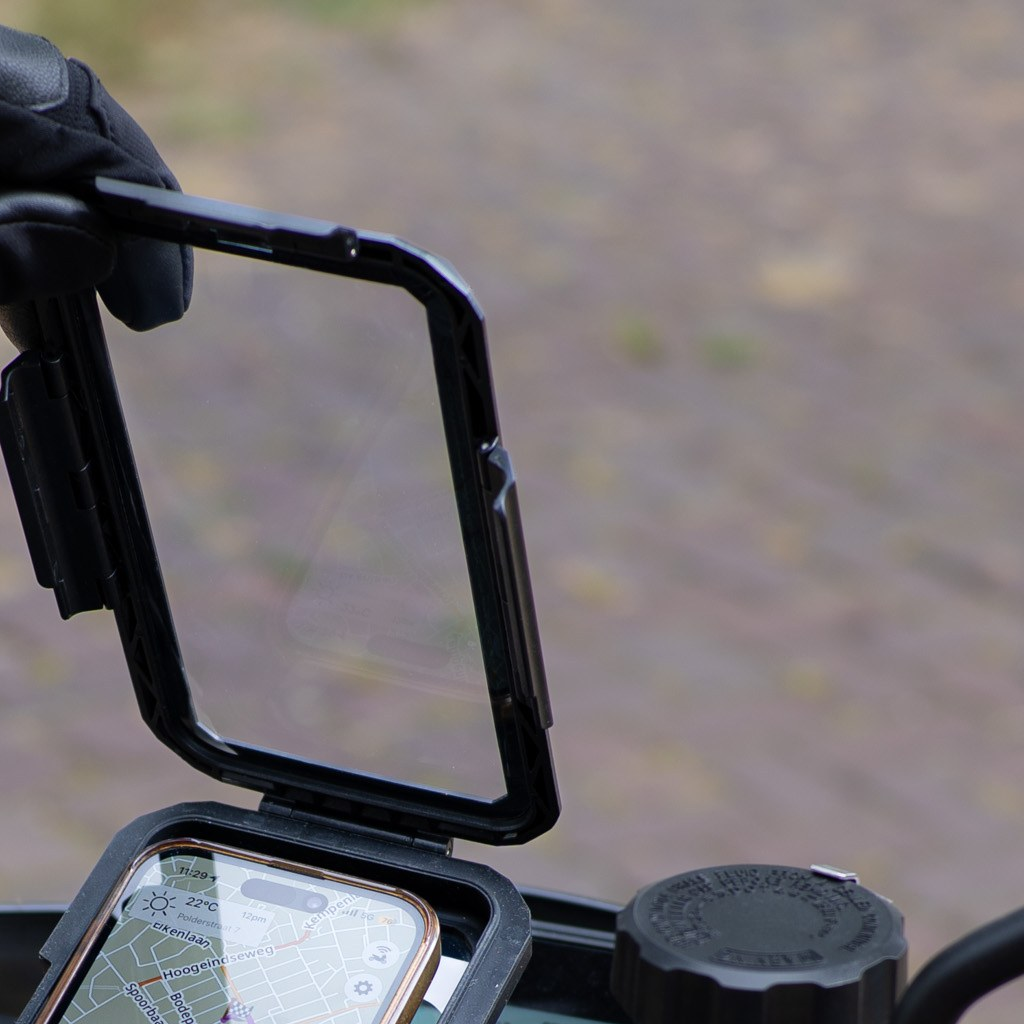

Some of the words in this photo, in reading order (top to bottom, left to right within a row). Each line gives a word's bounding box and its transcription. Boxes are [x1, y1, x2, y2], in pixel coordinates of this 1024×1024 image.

[179, 867, 208, 880] 11:29
[185, 896, 219, 912] 22°C
[177, 912, 231, 932] Polderstraat
[241, 911, 267, 923] 12pm
[361, 911, 374, 921] 5G
[163, 946, 274, 980] Hoogeindseweg
